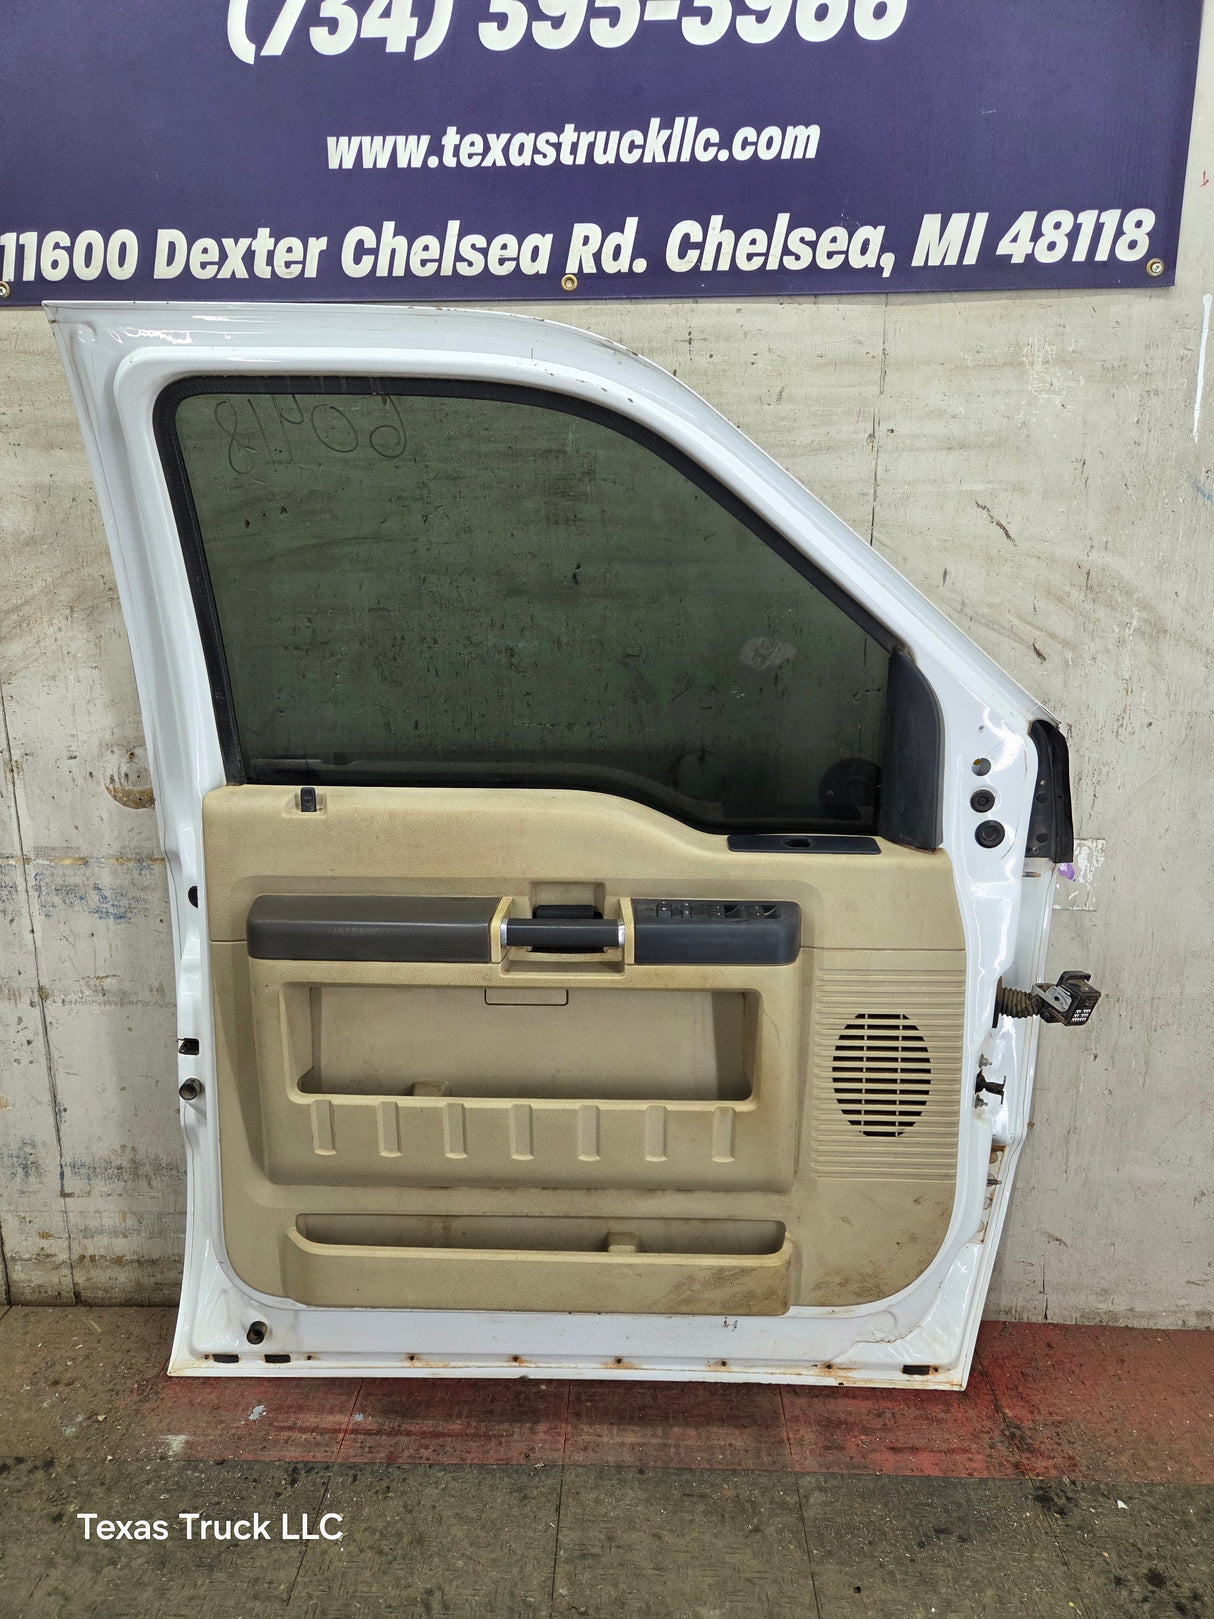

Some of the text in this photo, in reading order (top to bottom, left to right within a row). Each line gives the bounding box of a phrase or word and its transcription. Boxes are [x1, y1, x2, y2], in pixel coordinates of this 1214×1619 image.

[327, 117, 821, 170] www.texastruckllc.com
[0, 208, 1156, 281] 11600 Dexter Chelsea Rd. Chelsea, MI 48118
